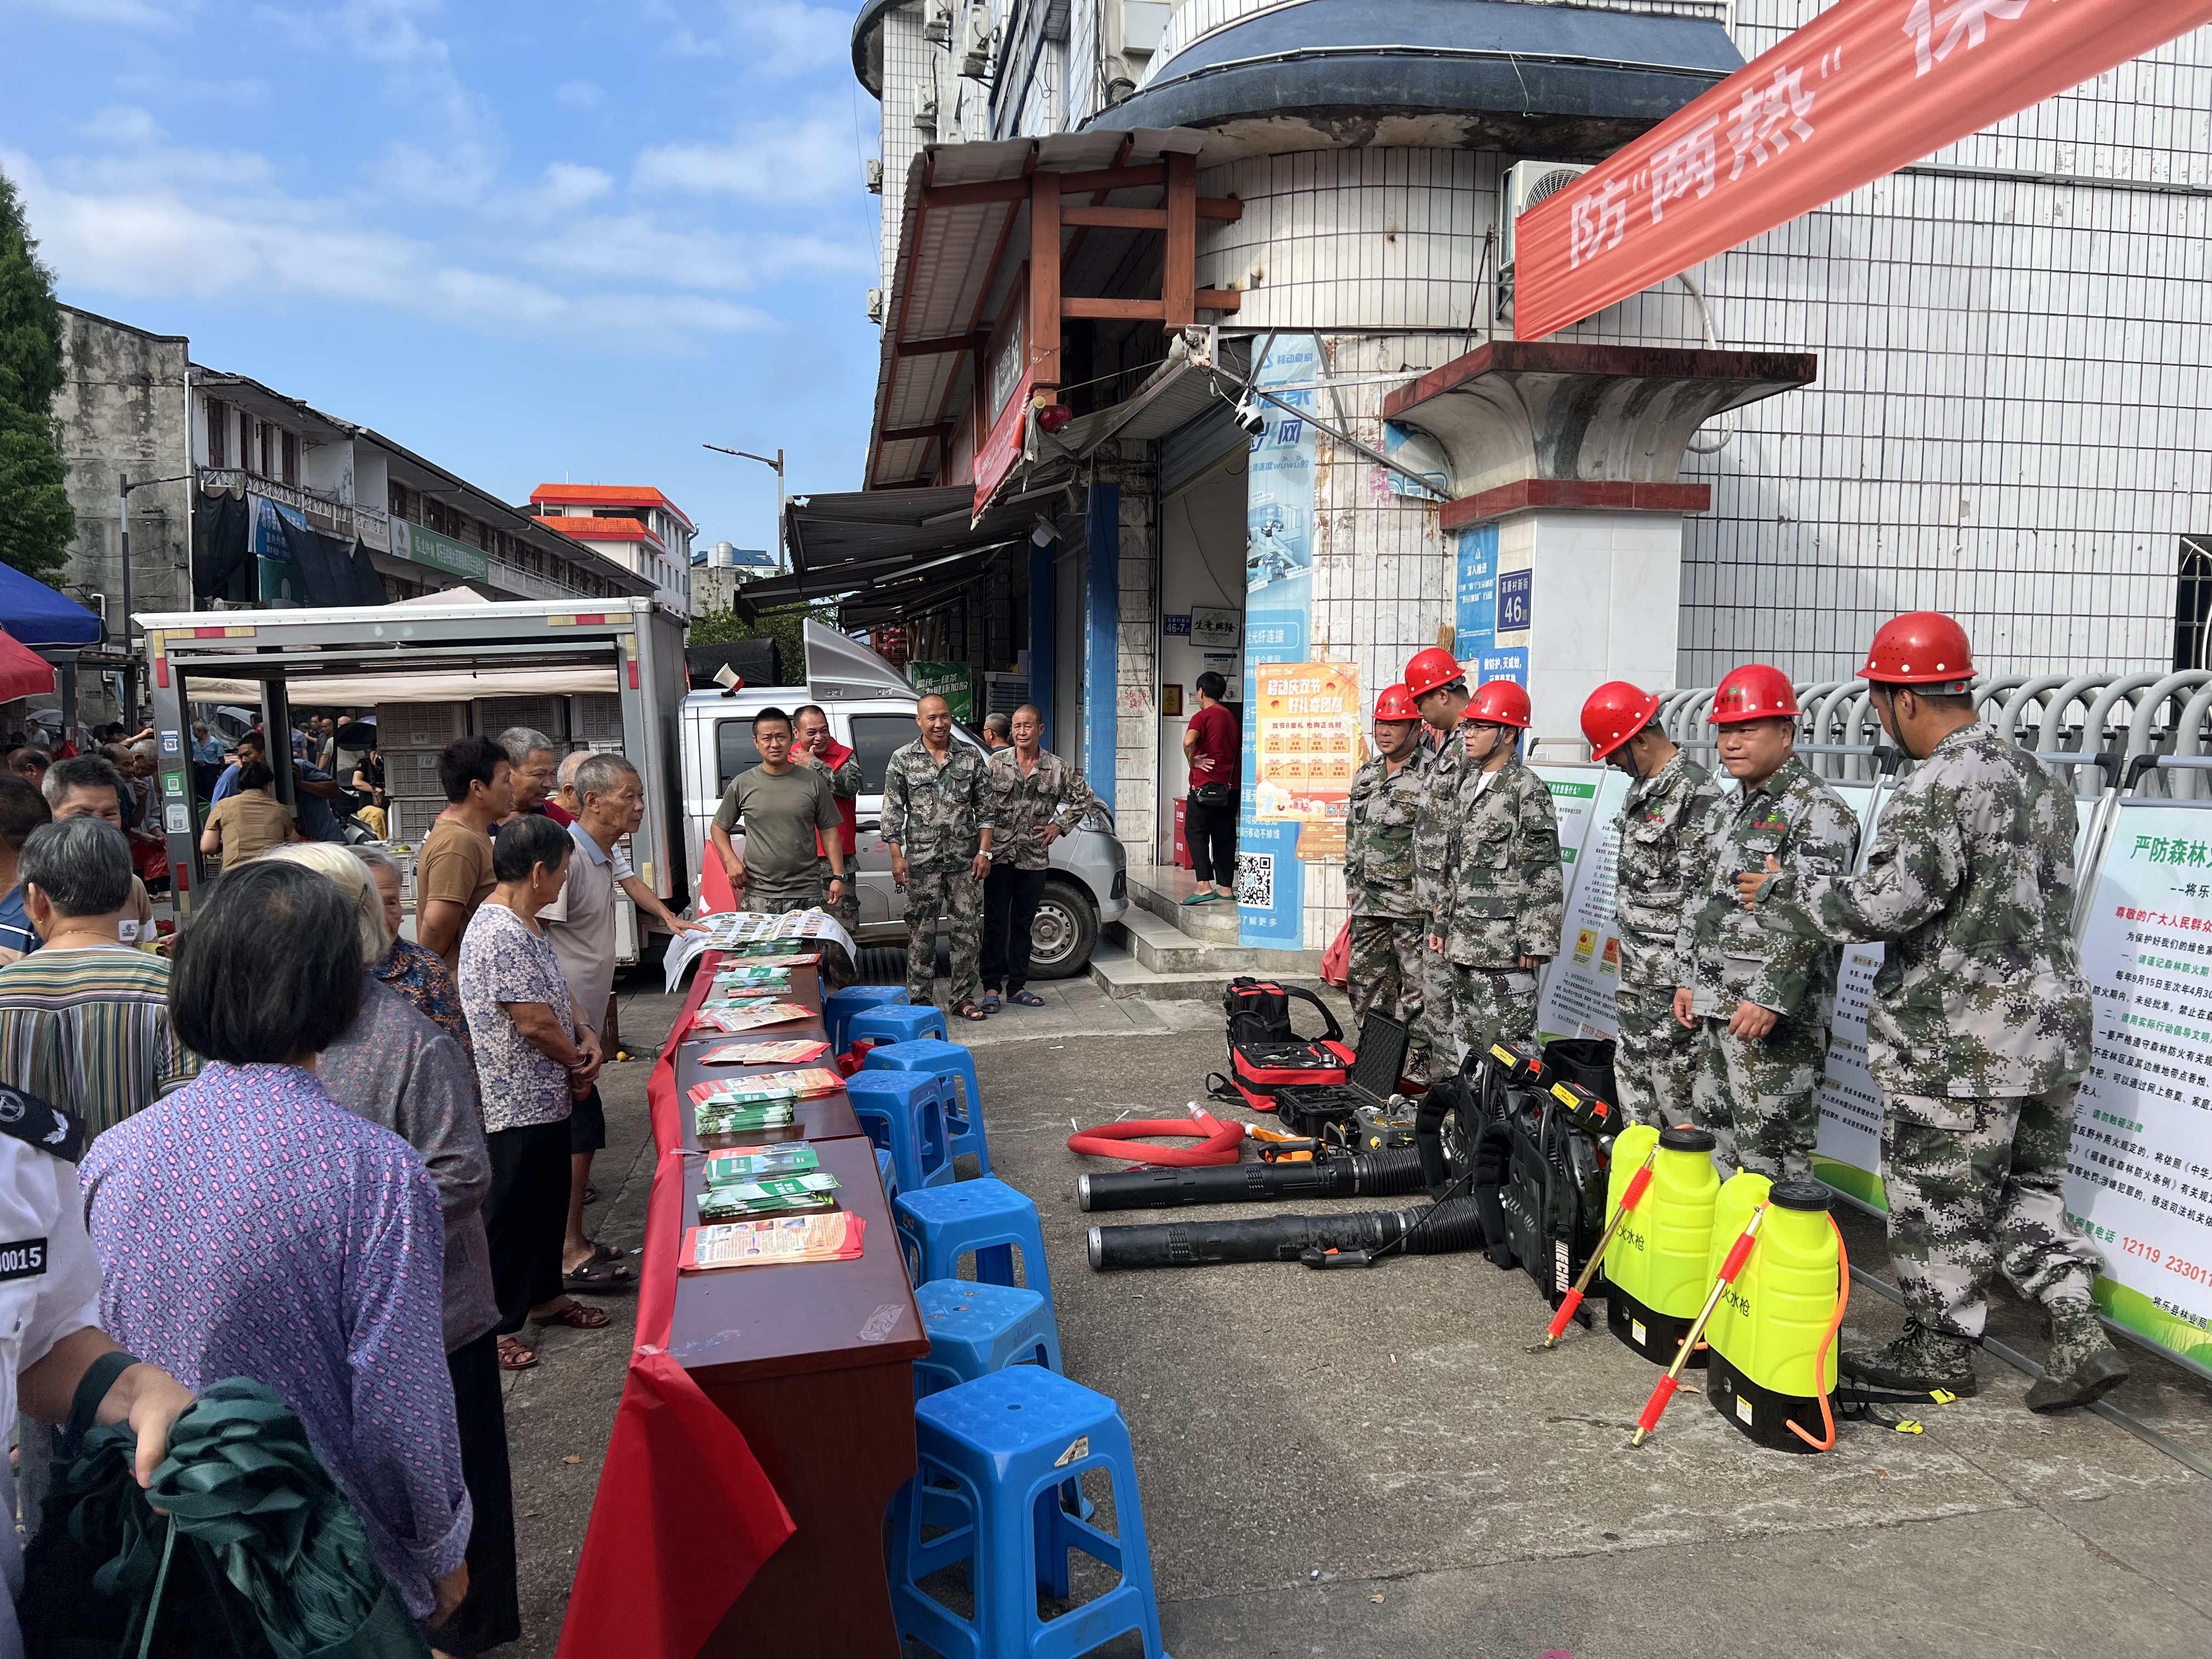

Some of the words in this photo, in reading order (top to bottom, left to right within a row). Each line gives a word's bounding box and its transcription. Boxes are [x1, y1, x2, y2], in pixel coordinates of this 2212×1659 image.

[1277, 353, 1313, 364] 移动爱家
[1504, 596, 1522, 623] 46
[1267, 678, 1322, 696] 移动庆双节
[2130, 835, 2212, 868] 严防森林
[1238, 915, 1277, 927] 了解更多
[2104, 1009, 2212, 1043] 二、请用实际行动倡导文明
[2073, 1124, 2212, 1180] 违反野外用火规定的，将依照《中华
[1617, 1224, 1644, 1251] 火水枪
[2123, 1237, 2161, 1263] 12119
[0, 1246, 41, 1272] 0015
[1556, 1254, 1569, 1293] ECHO
